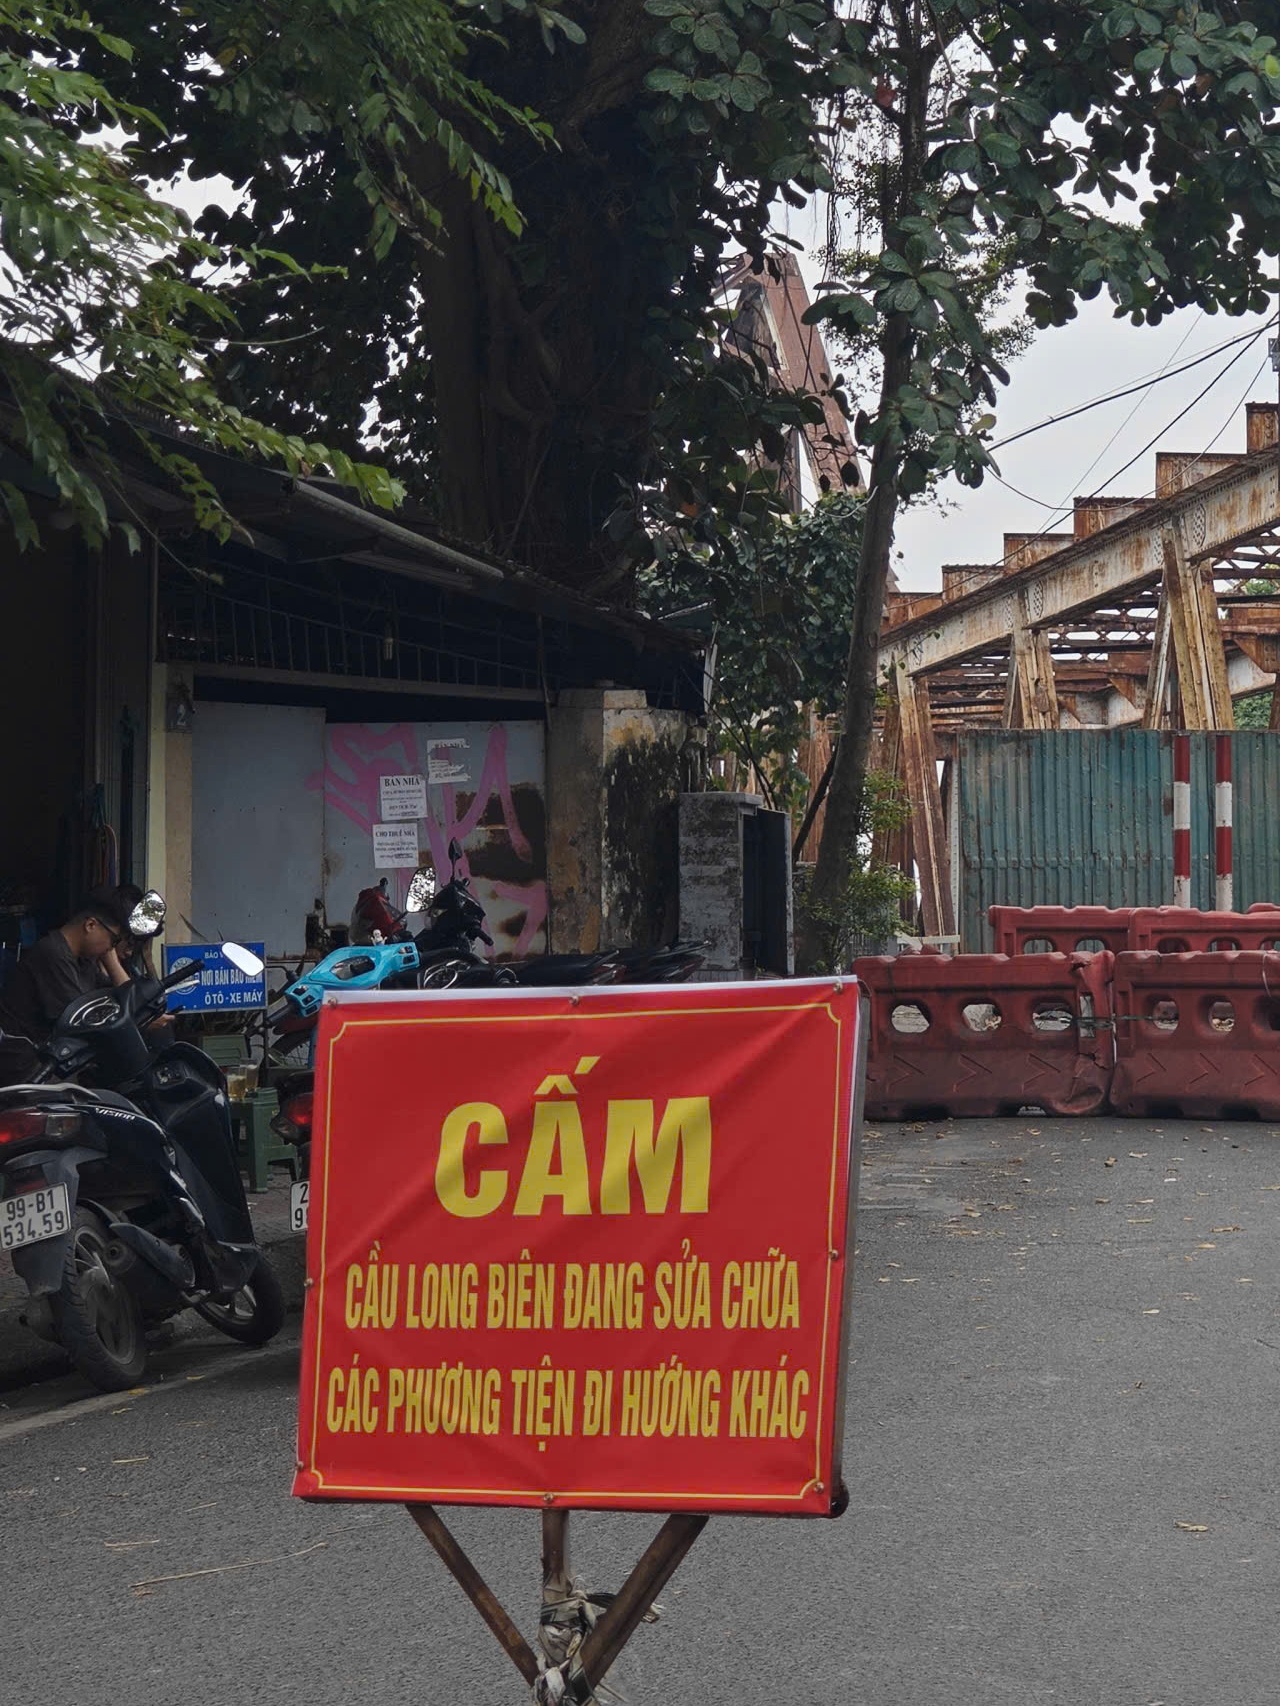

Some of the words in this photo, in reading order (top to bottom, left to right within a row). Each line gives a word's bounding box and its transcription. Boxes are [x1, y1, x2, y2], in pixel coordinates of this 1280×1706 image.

[214, 967, 229, 985] BÁN
[230, 992, 241, 1004] XE
[243, 989, 263, 1003] MÁY
[95, 1106, 136, 1121] VISION
[435, 1056, 712, 1218] CẤM
[6, 1189, 55, 1222] 99-B1
[3, 1210, 65, 1247] 534.59
[345, 1240, 400, 1330] CẦU
[406, 1262, 479, 1330] LONG
[486, 1248, 555, 1329] BIÊN
[563, 1262, 644, 1330] ĐANG
[653, 1238, 712, 1330] SỬA
[721, 1247, 800, 1330] CHỮA
[326, 1353, 380, 1434] CÁC
[387, 1361, 502, 1436] PHƯƠNG
[511, 1354, 576, 1452] TIỆN
[582, 1369, 614, 1436] ĐI
[620, 1354, 721, 1438] HƯỚNG
[729, 1354, 810, 1439] KHÁC
